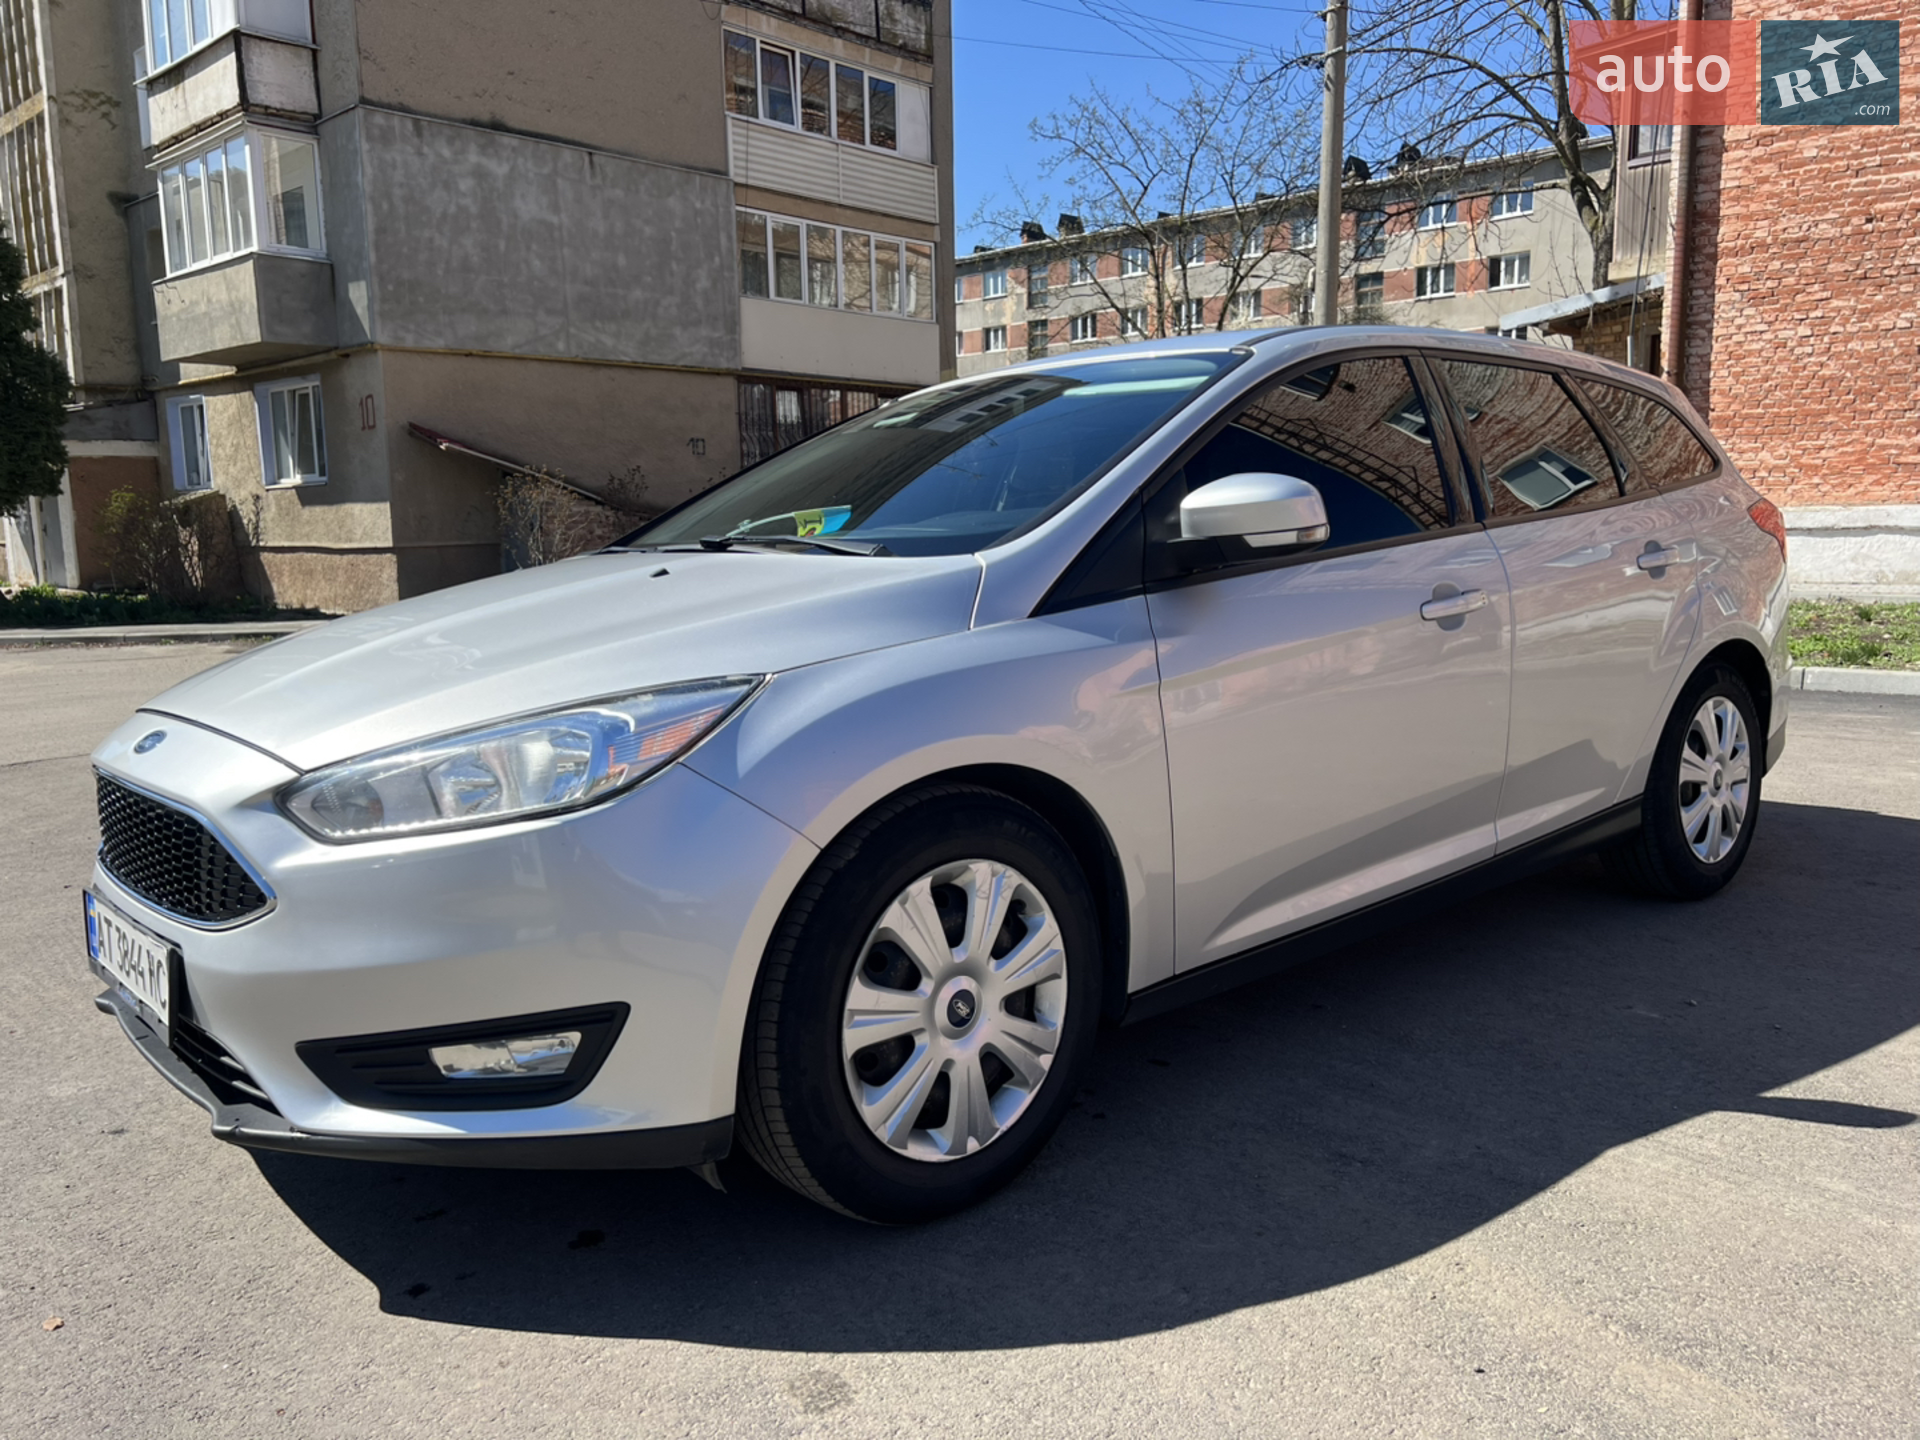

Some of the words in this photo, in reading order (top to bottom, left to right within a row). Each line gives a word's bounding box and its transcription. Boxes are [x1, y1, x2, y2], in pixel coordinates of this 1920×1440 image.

[359, 393, 376, 431] 10
[685, 437, 706, 456] 10
[97, 911, 113, 965] AT
[115, 925, 146, 992] 3844
